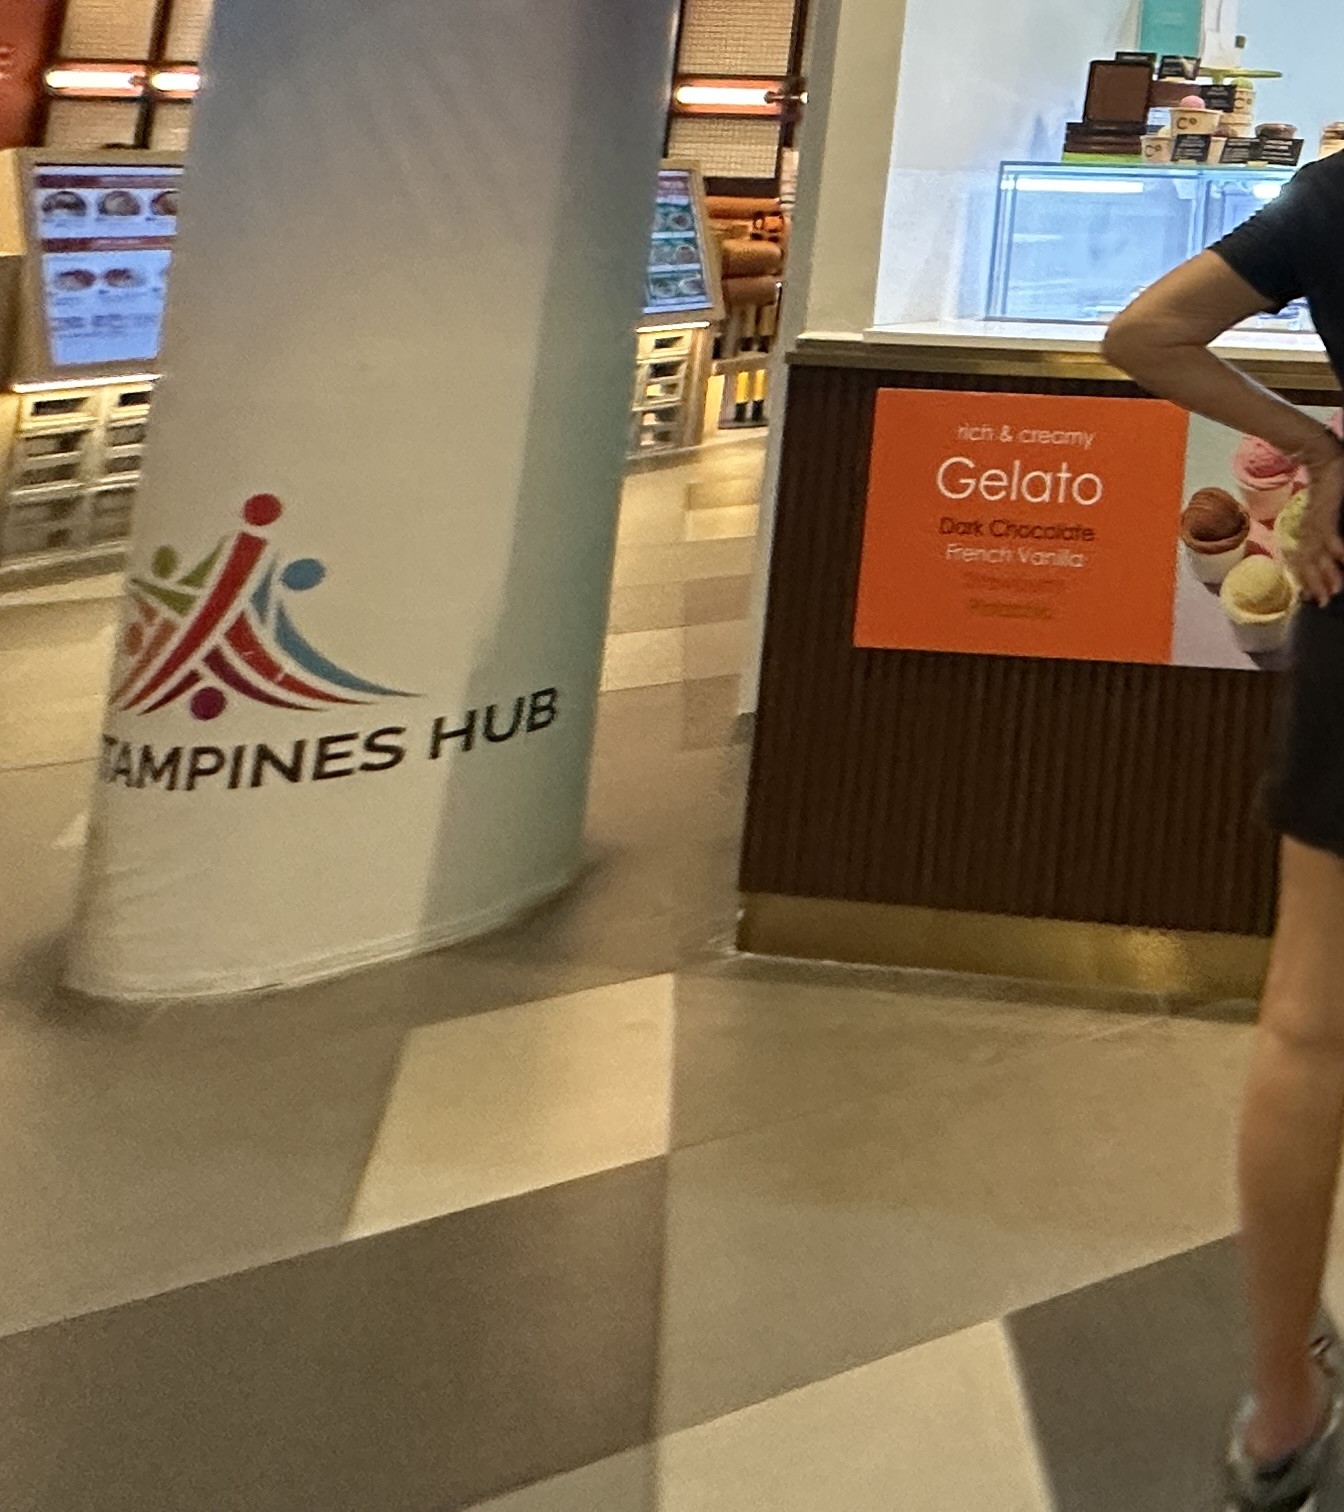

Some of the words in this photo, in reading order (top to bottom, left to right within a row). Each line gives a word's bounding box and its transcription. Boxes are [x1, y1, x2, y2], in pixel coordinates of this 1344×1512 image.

[957, 423, 994, 442] rich
[1000, 424, 1014, 443] &
[1018, 427, 1096, 451] creamy
[936, 455, 1104, 506] Gelato
[938, 516, 984, 536] Dark
[988, 518, 1096, 542] Chocolate
[946, 543, 1014, 563] French
[1018, 547, 1085, 568] Vanilla
[102, 726, 407, 792] TAMPINES
[427, 687, 558, 760] HUB
